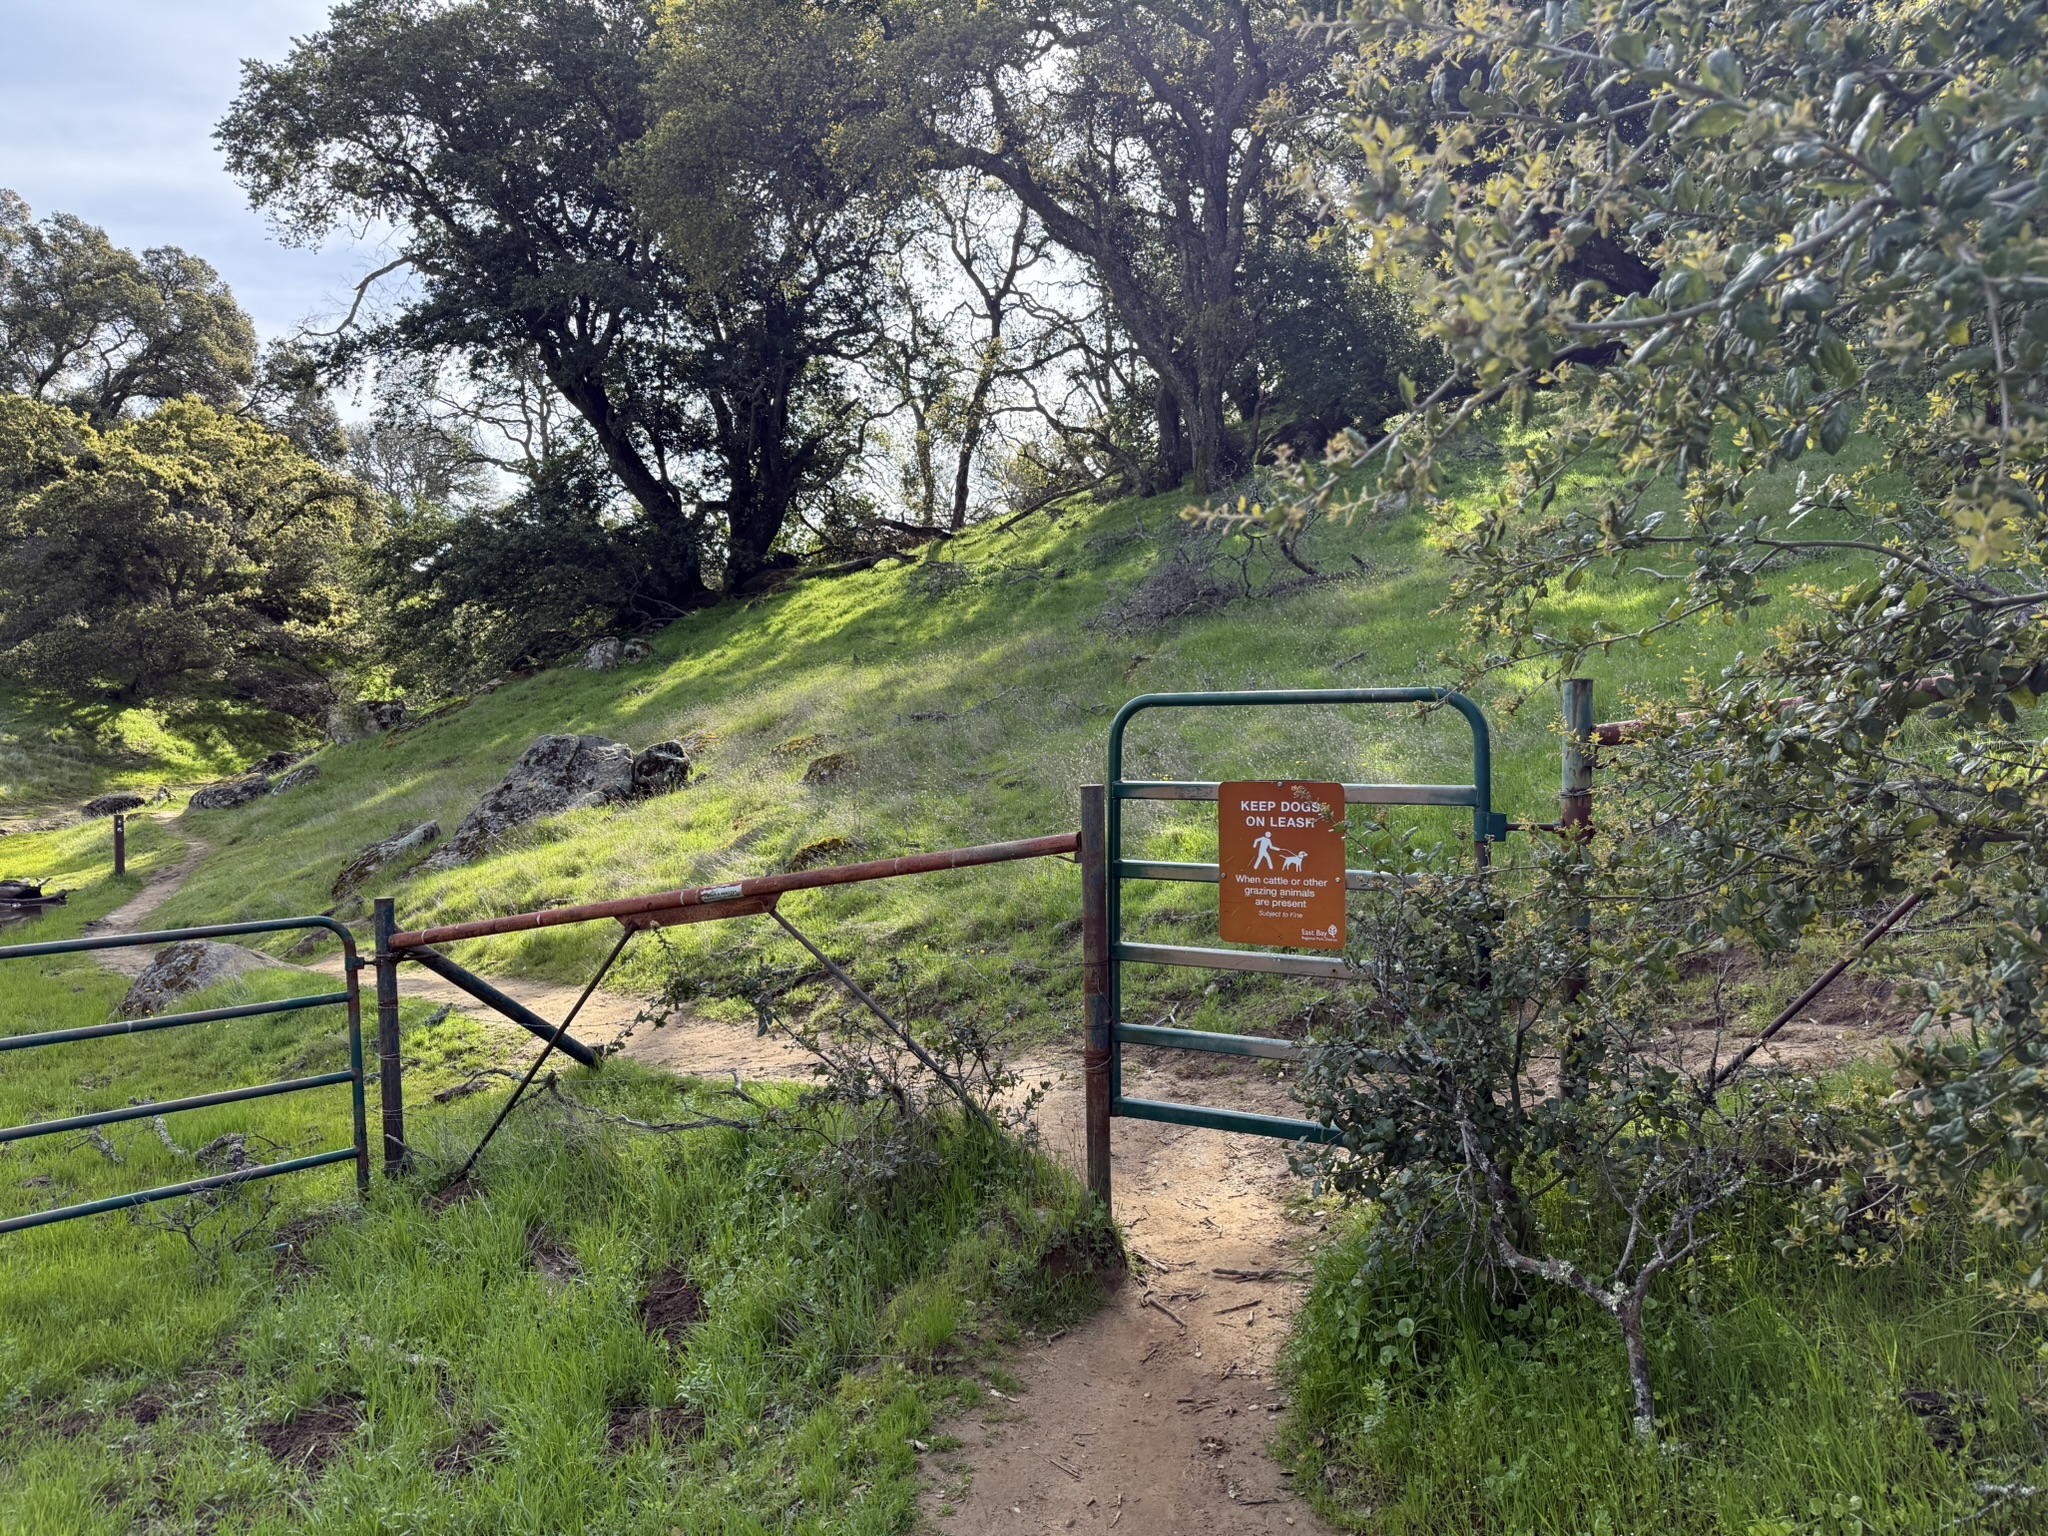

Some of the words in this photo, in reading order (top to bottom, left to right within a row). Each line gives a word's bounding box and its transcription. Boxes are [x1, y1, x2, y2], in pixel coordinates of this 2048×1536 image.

[1241, 801, 1276, 811] KEEP
[1281, 802, 1320, 813] DOGS
[1246, 816, 1265, 827] ON
[1270, 817, 1315, 828] LEASH
[1235, 874, 1261, 883] When
[1263, 876, 1288, 885] cattle
[1303, 878, 1328, 887] other
[1244, 887, 1277, 897] grazing
[1280, 888, 1315, 897] animals
[1272, 900, 1306, 908] present
[1258, 910, 1281, 918] Subject
[1301, 928, 1314, 936] East
[1316, 929, 1327, 938] Bay
